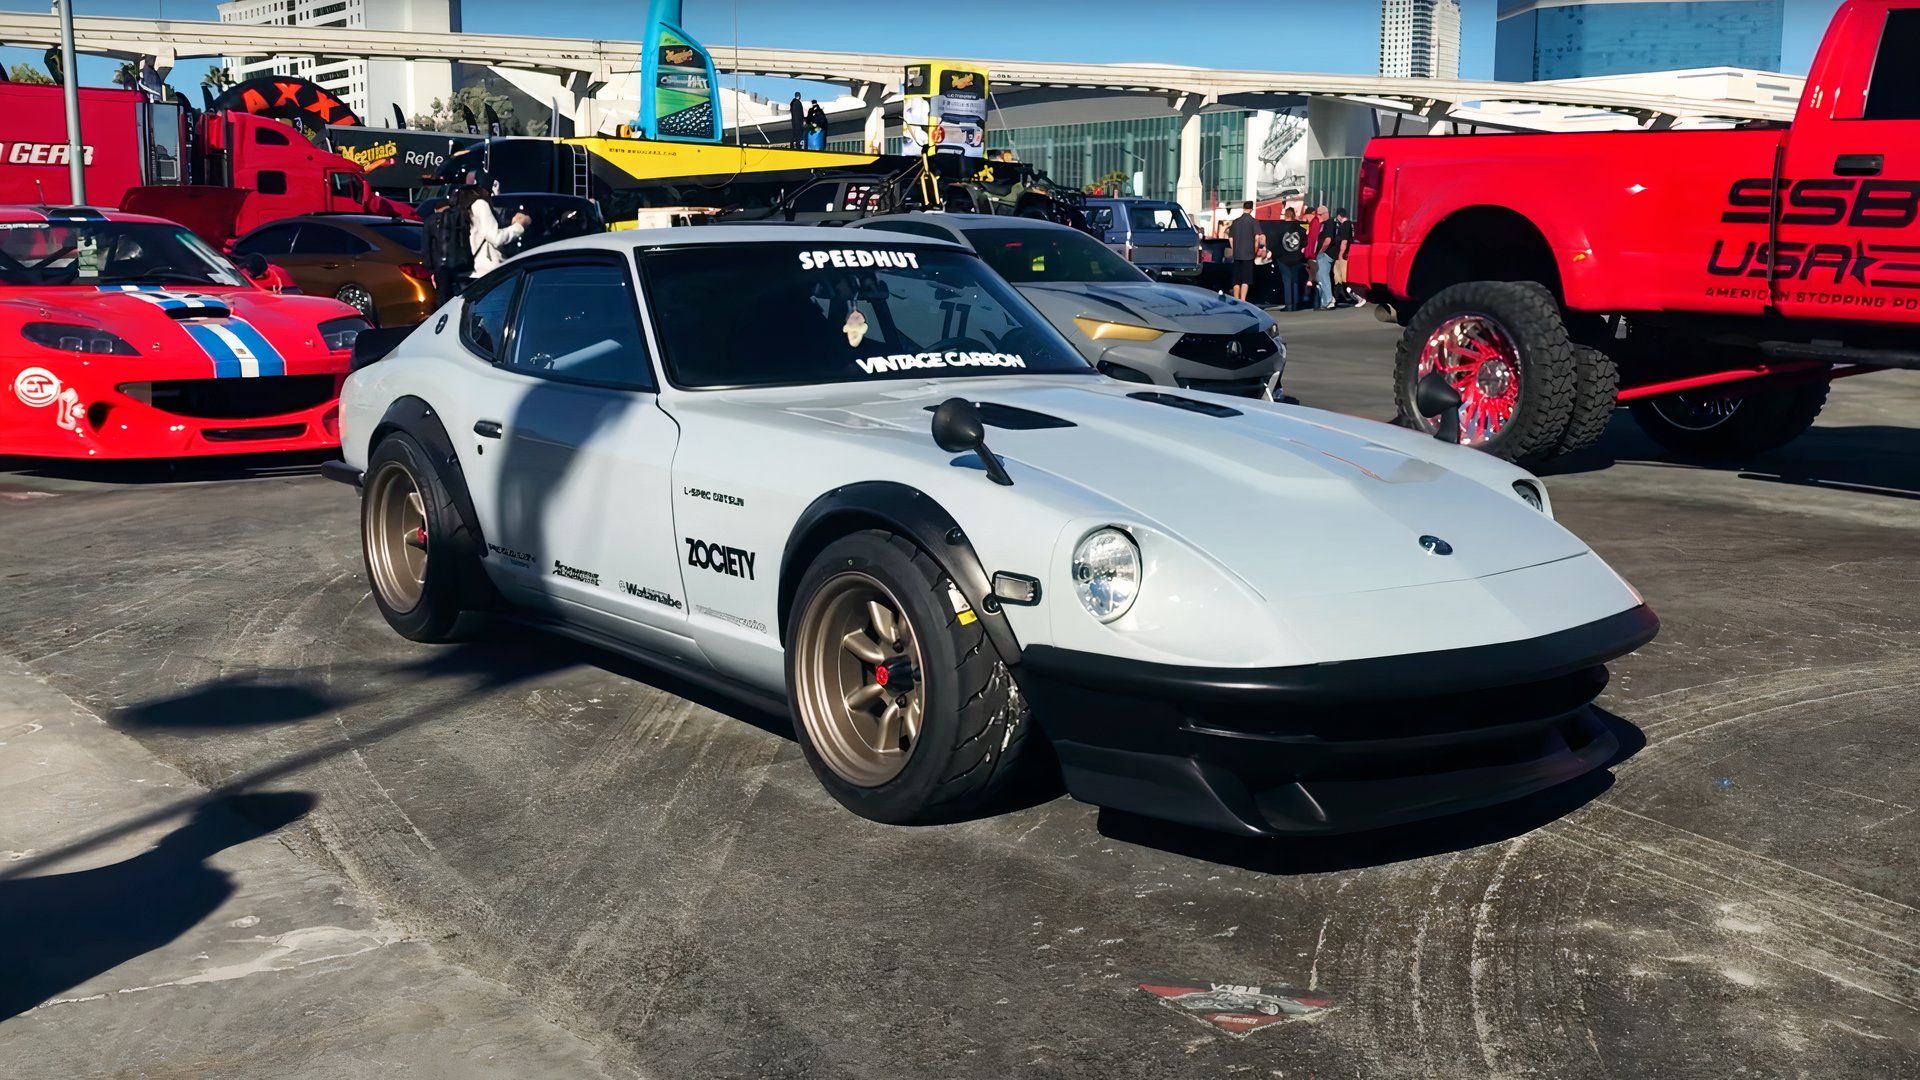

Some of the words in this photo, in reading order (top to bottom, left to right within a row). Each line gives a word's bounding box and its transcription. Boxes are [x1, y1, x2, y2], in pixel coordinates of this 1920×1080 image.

[799, 250, 919, 269] SPEEDHUT
[1707, 240, 1852, 284] USA
[1705, 287, 1790, 301] AMERICN
[1796, 292, 1885, 307] STOPPING
[856, 353, 947, 374] VINTAGE
[945, 352, 1026, 368] CARBON
[685, 537, 755, 580] ZOCIETY
[625, 581, 682, 609] Watanabe
